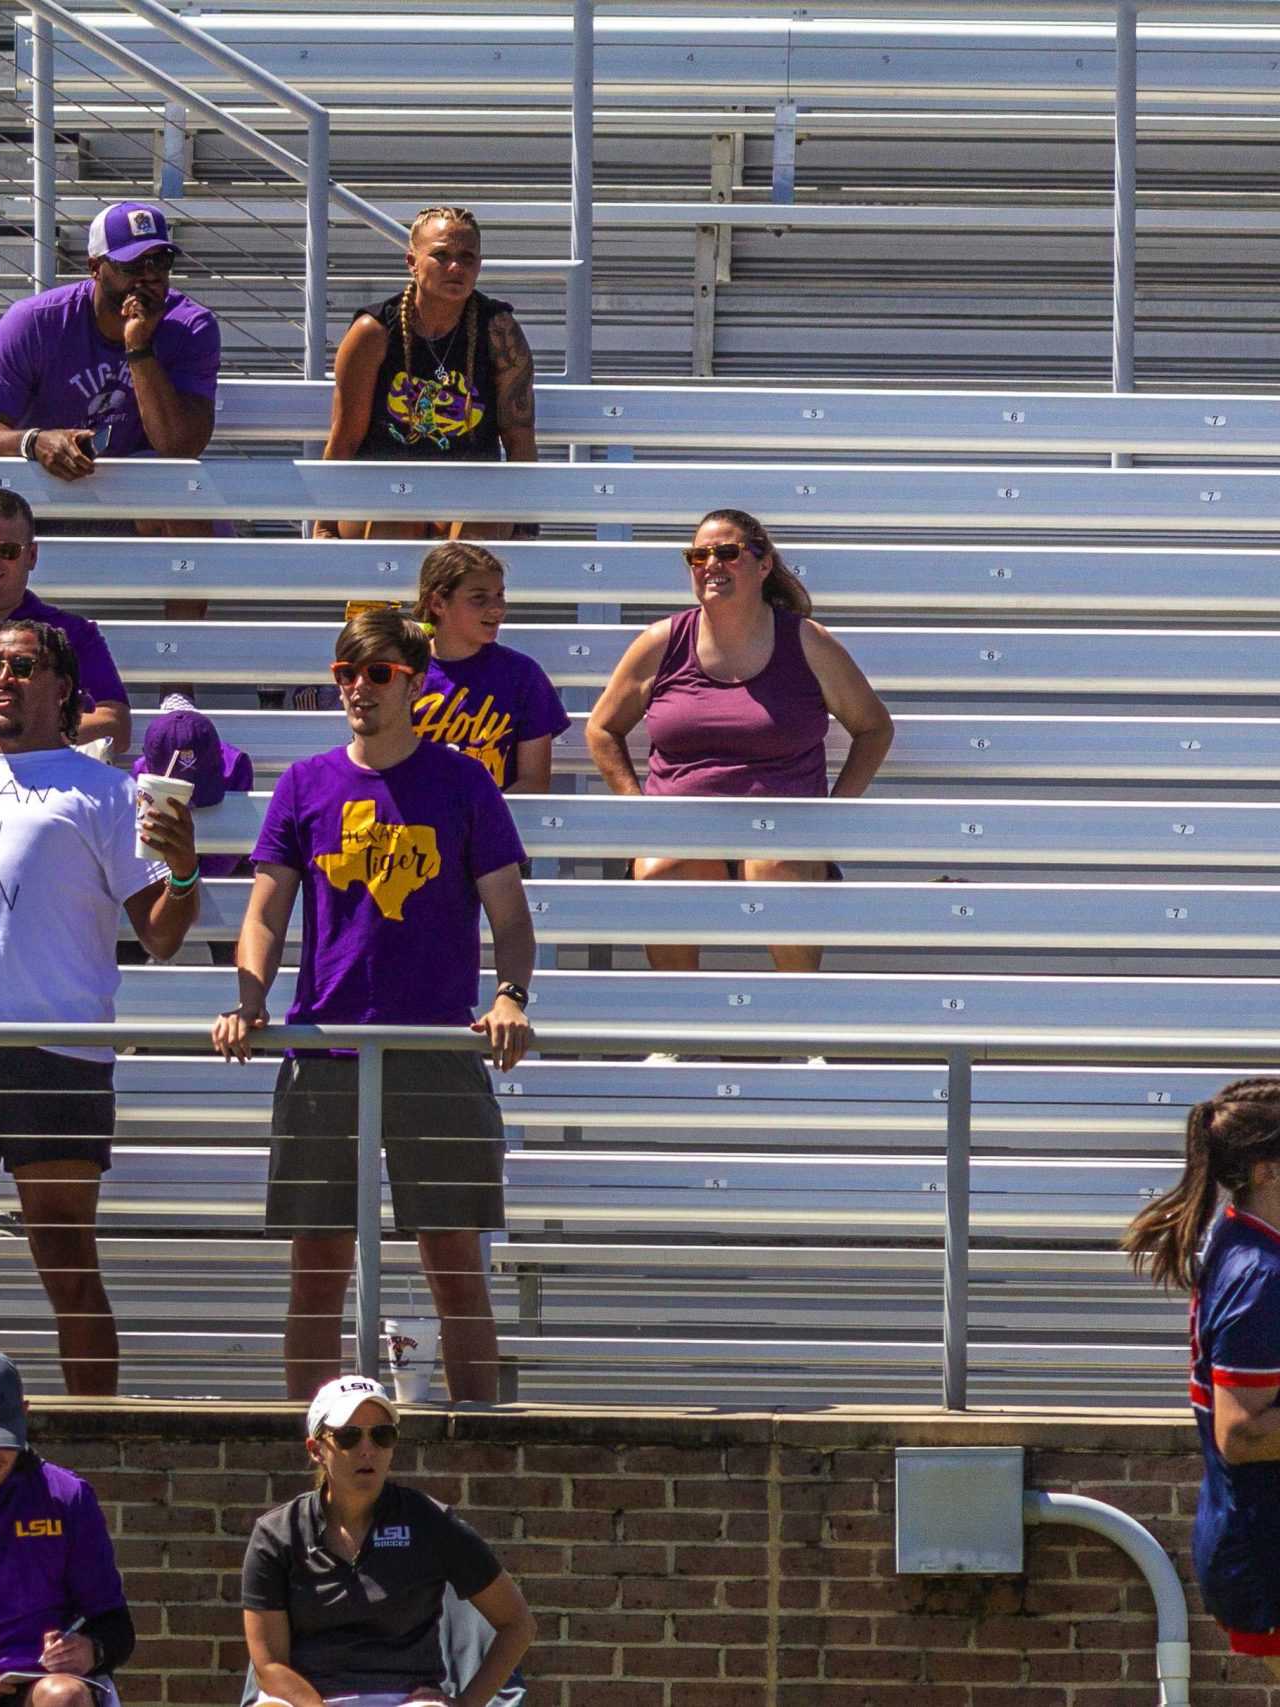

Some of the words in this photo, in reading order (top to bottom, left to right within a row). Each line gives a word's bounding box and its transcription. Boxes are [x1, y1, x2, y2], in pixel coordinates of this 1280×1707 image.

[412, 687, 512, 750] Holy
[15, 1519, 62, 1537] LSU
[373, 1526, 410, 1541] LSU
